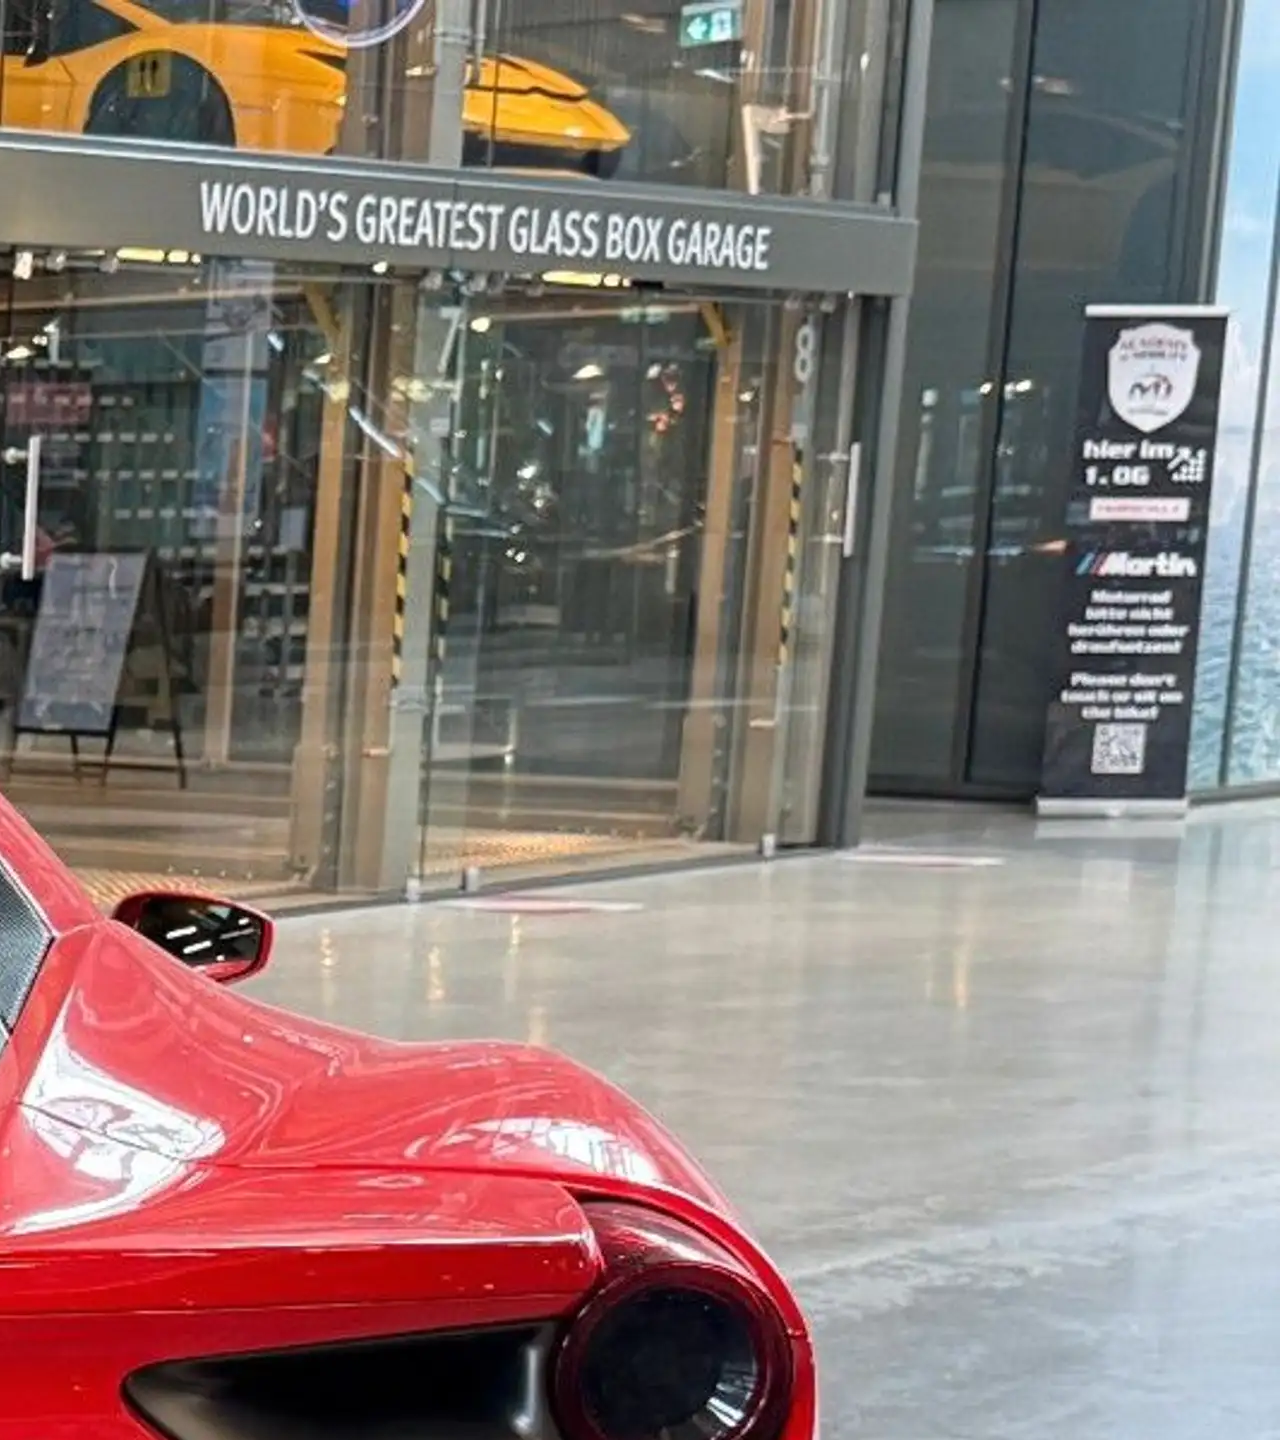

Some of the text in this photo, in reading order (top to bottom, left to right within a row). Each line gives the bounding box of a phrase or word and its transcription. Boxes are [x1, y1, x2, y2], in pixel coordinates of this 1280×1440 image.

[200, 180, 773, 271] WORLD'S GREATEST GLASS BOX GARAGE
[794, 323, 816, 383] 8
[1082, 439, 1137, 460] hier
